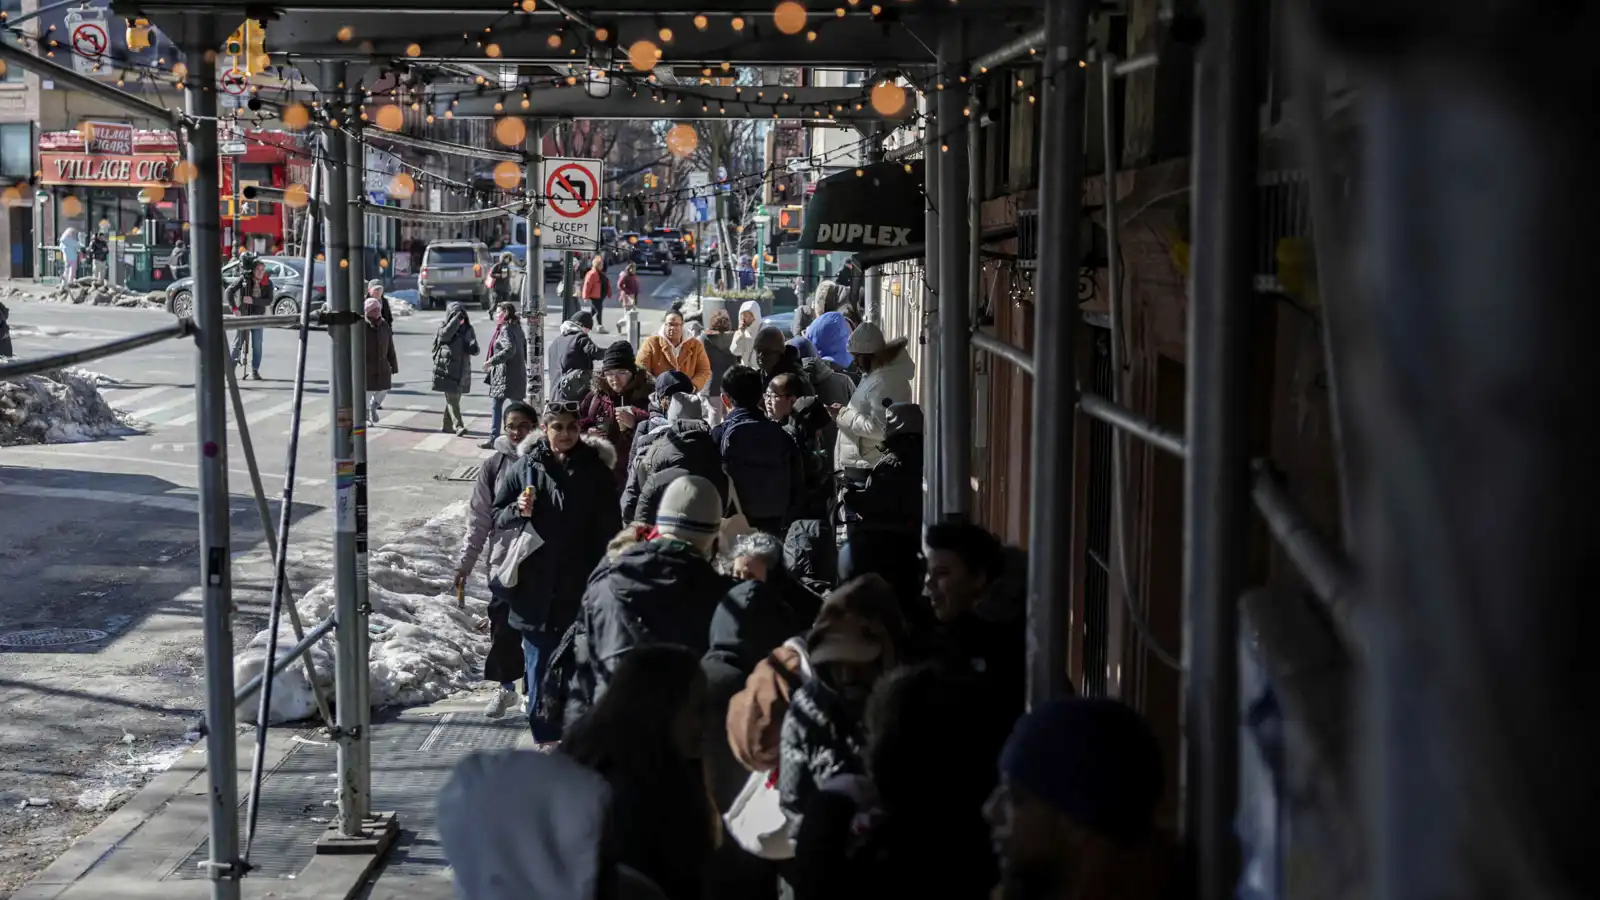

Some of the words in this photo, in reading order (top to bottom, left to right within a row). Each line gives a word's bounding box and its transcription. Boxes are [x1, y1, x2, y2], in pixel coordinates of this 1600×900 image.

[54, 159, 131, 181] VILLAGE
[136, 159, 180, 182] CIG
[552, 221, 588, 233] EXCEPT
[817, 223, 911, 247] DUPLEX
[555, 234, 585, 245] BIKES
